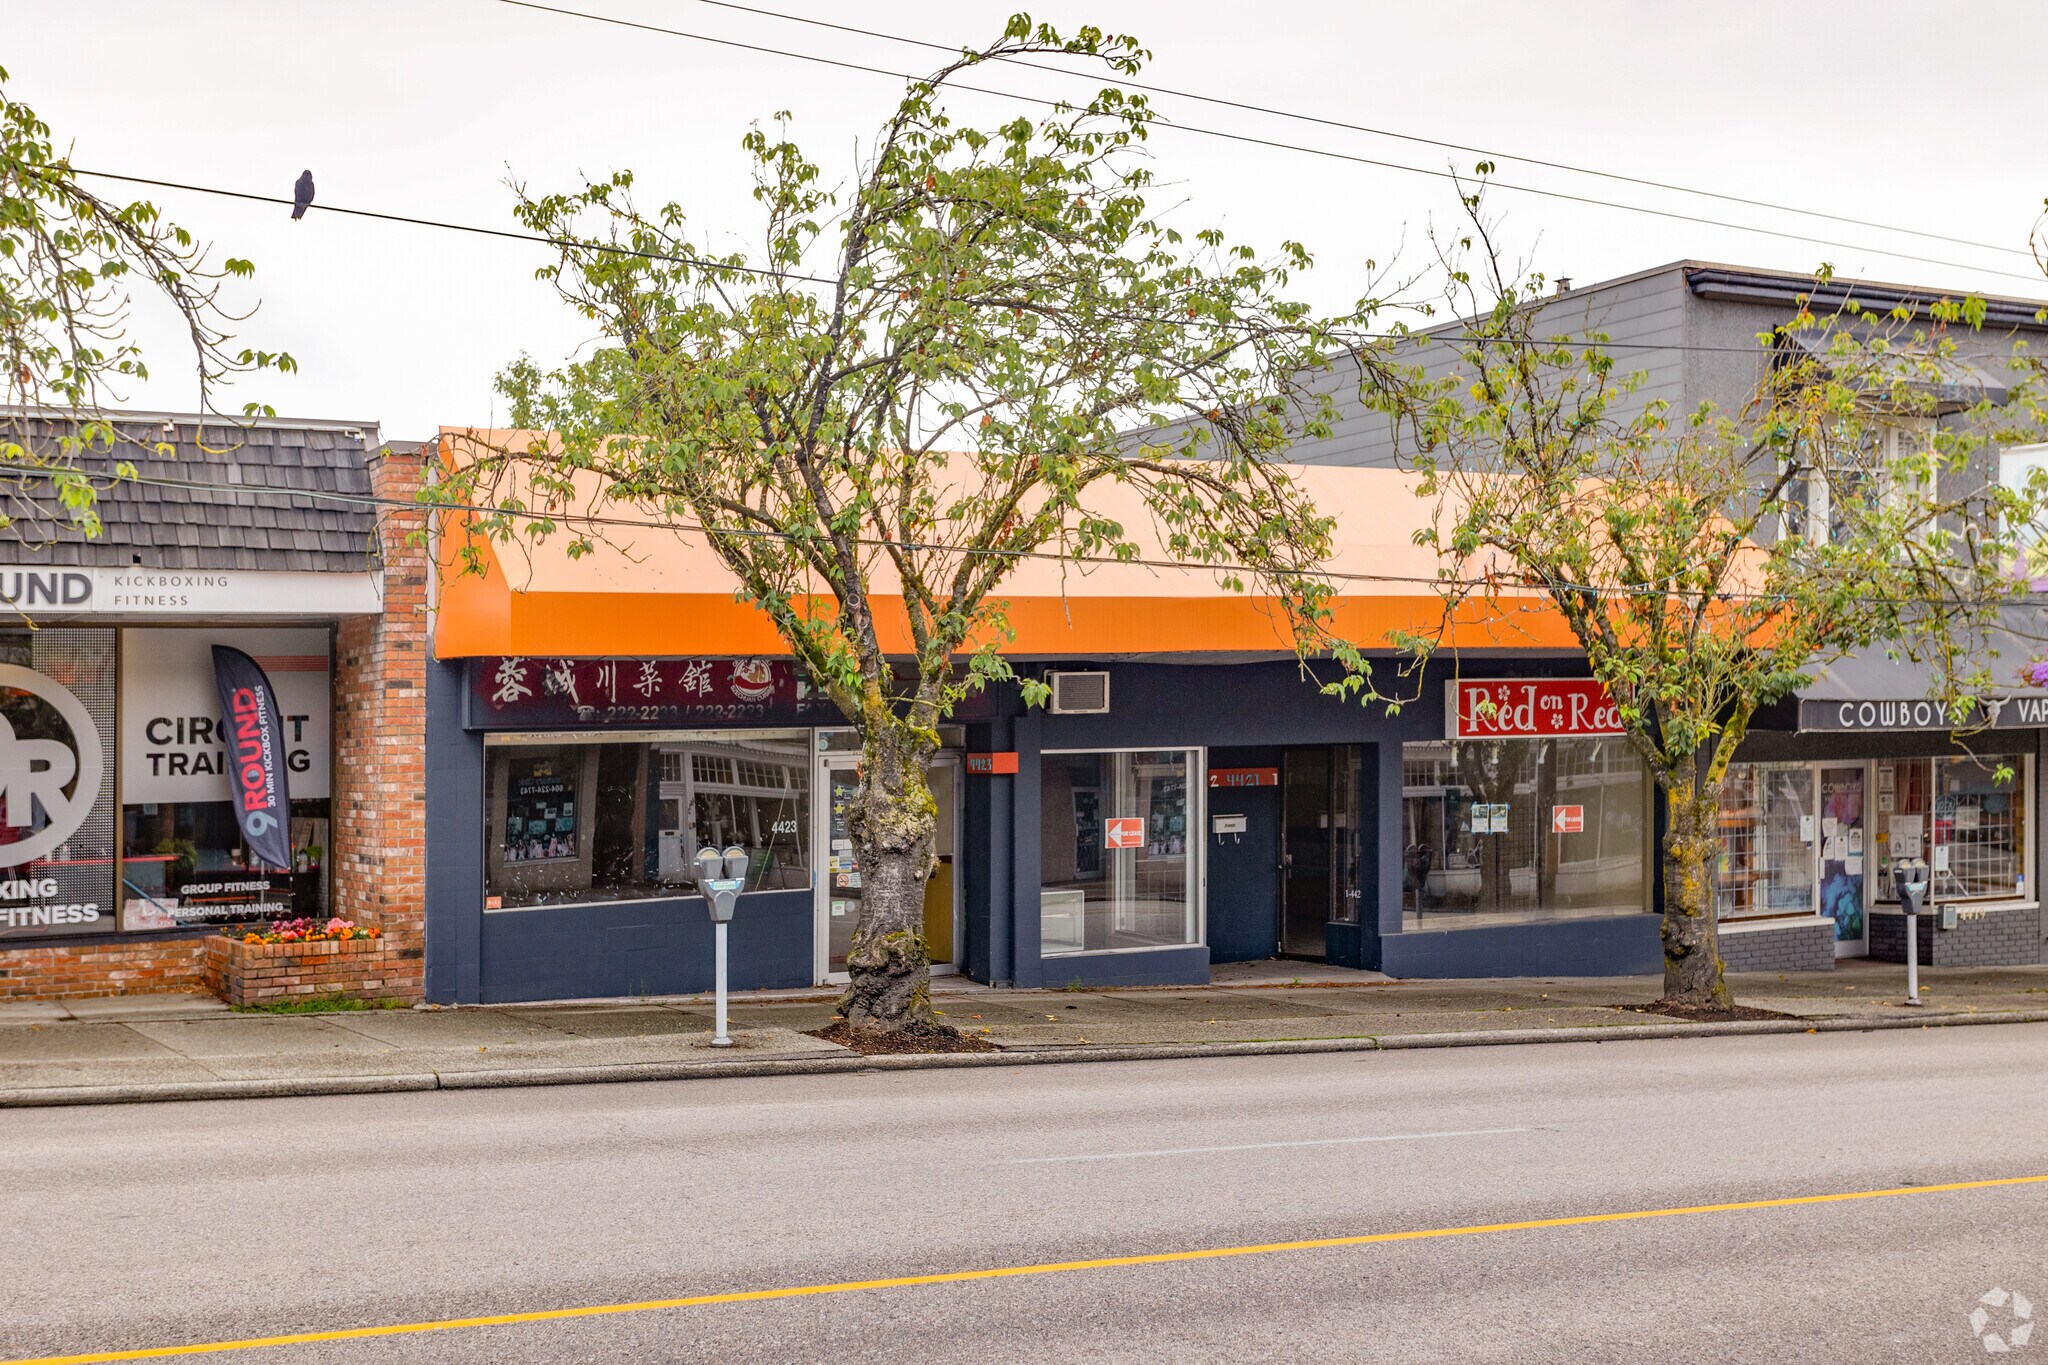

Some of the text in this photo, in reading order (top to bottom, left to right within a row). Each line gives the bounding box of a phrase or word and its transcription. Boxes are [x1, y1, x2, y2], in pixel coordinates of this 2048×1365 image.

[114, 576, 228, 587] KICKBOXING
[114, 595, 188, 606] FITNESS
[1465, 685, 1537, 732] Red
[1540, 694, 1563, 710] on
[254, 685, 276, 808] 30 MIN KICKBOX FITNESS
[970, 758, 992, 771] 4423
[1209, 772, 1279, 788] 2 4421 1
[771, 820, 798, 834] 4423
[181, 881, 271, 895] GROUP FITNESS
[167, 902, 284, 918] PERSONAL TRAINING
